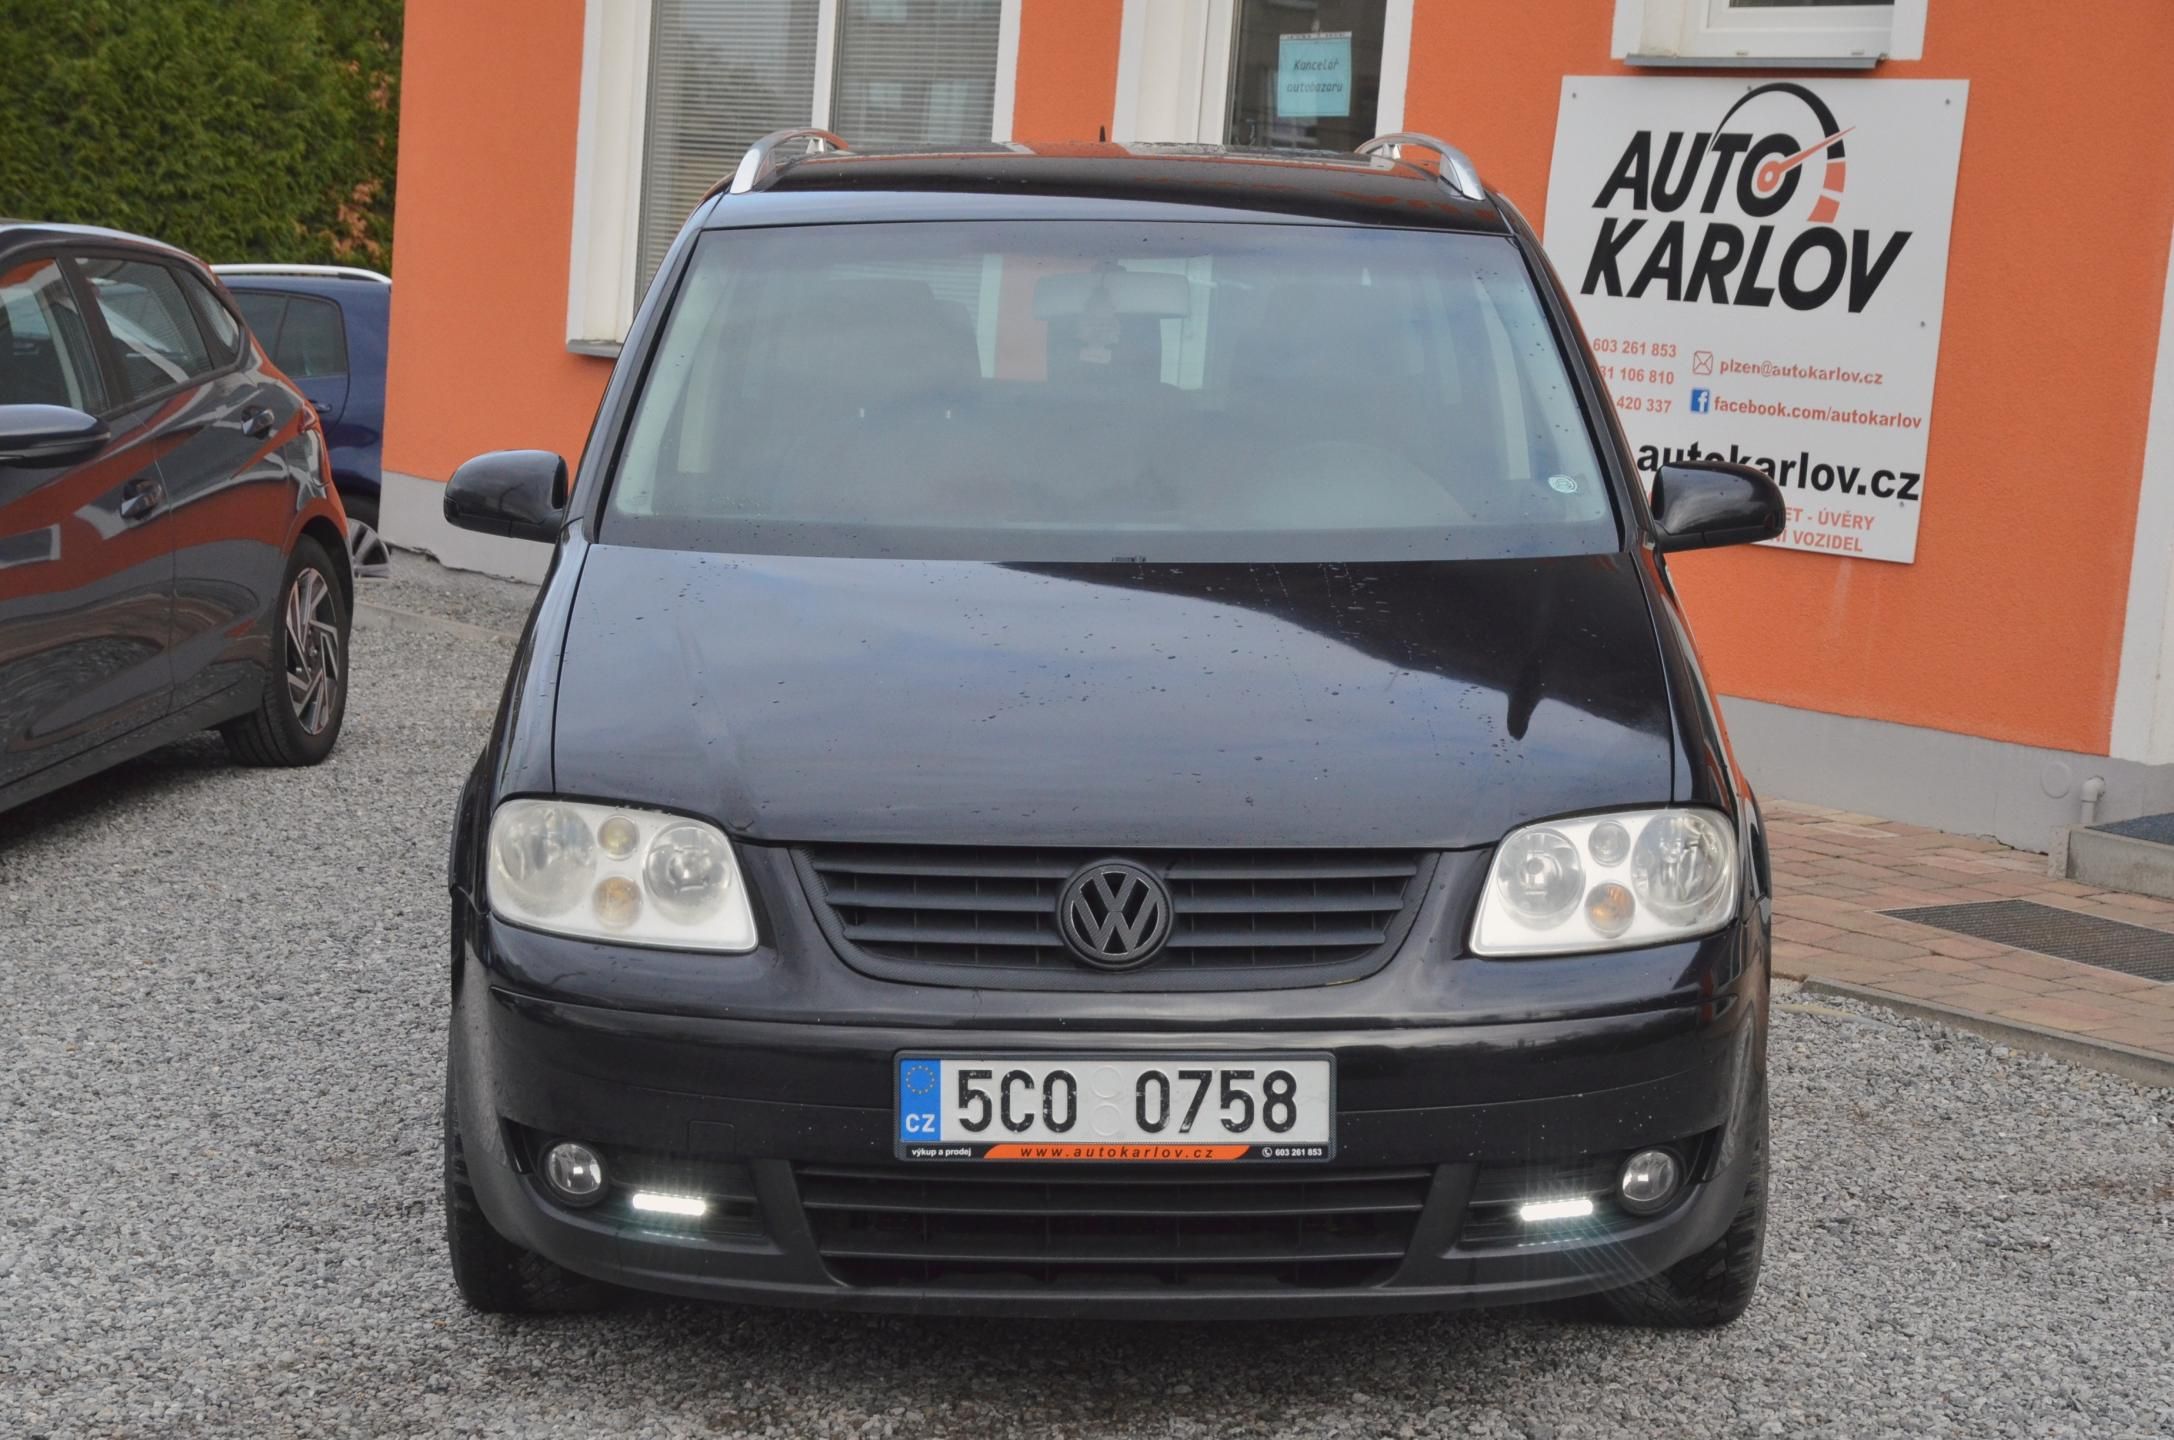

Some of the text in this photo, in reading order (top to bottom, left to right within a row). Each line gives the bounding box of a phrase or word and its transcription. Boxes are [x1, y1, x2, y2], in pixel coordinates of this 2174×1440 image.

[1592, 130, 1802, 217] AUTO
[1580, 217, 1913, 313] KARLOV
[1593, 338, 1677, 358] 603 261 853
[1620, 367, 1644, 382] 106
[1649, 369, 1674, 385] 810
[1720, 359, 1883, 385] plzen@autokarlov.cz
[1616, 396, 1672, 413] 420 337
[1714, 396, 1922, 429] facebook.com/autokarlov
[1793, 530, 1863, 552] VOZIDEL
[1135, 1069, 1298, 1134] 0758
[905, 1114, 936, 1134] CZ
[911, 1147, 972, 1159] výkup a prodej
[1020, 1147, 1214, 1159] www.autokarlov.cz
[1275, 1147, 1290, 1157] 603
[1307, 1147, 1322, 1157] 853
